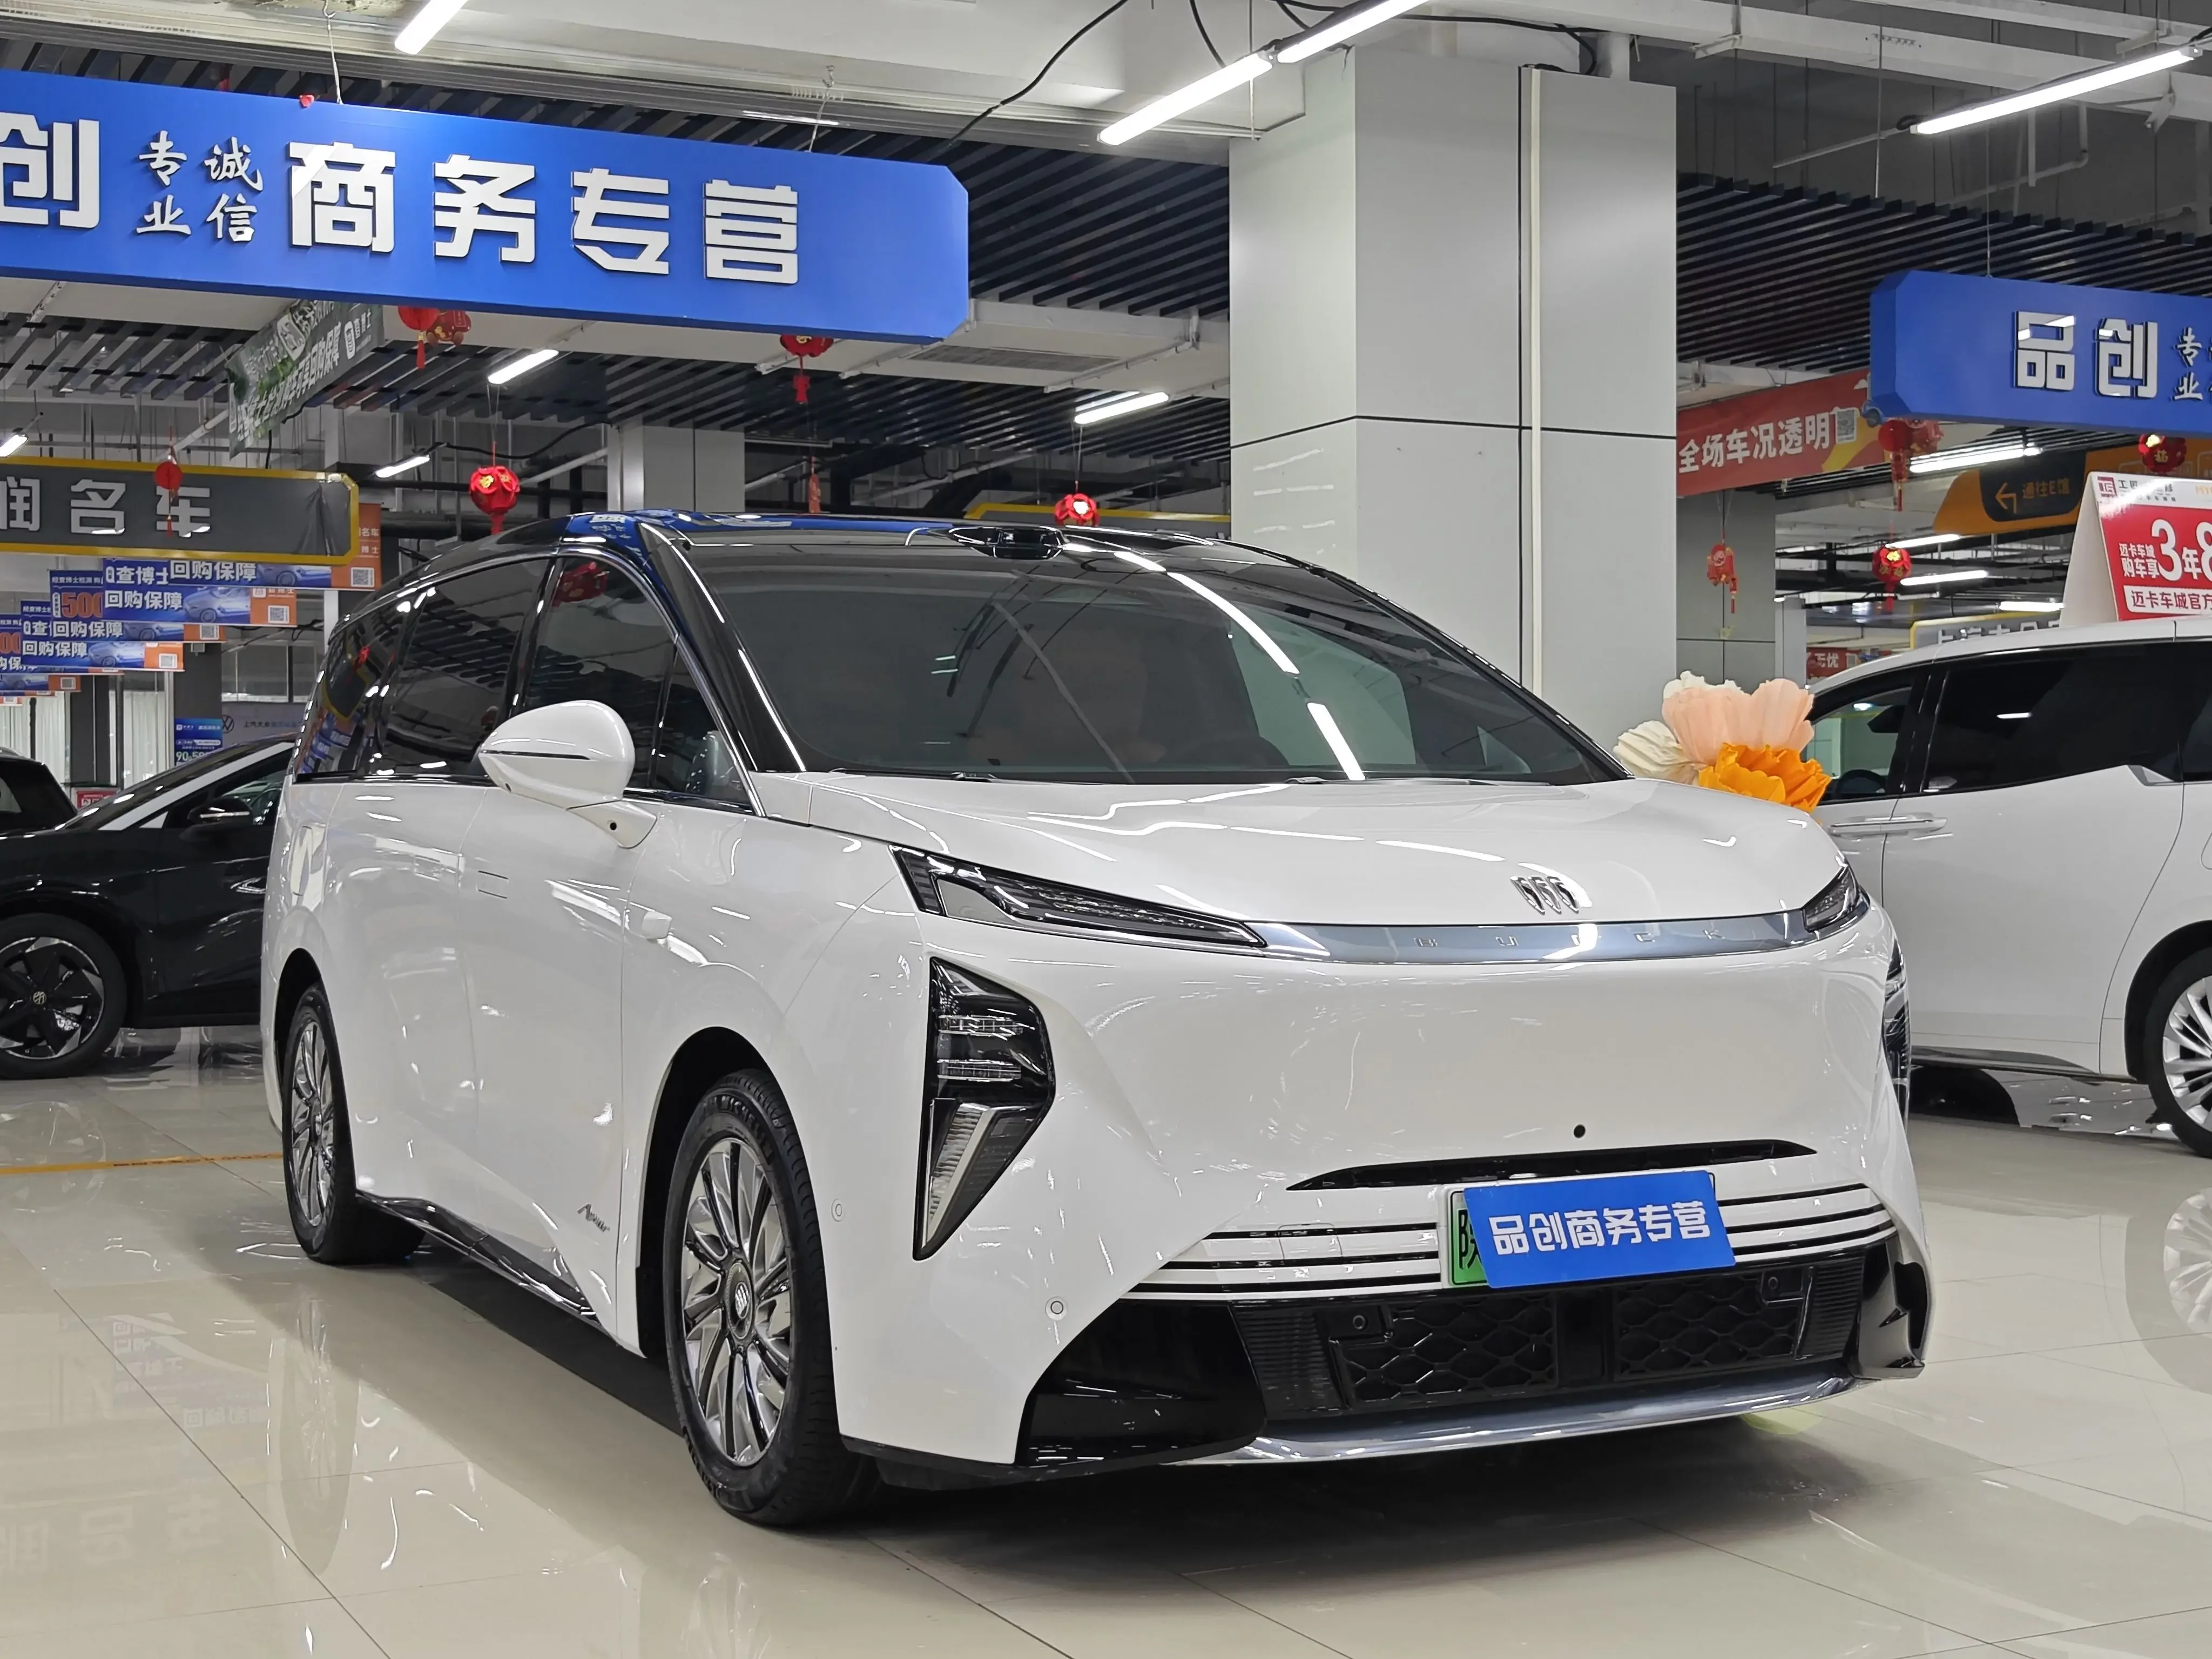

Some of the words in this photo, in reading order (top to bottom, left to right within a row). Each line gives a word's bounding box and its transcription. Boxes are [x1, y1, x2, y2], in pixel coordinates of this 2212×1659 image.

[0, 112, 99, 228] 创
[289, 141, 798, 285] 商务专营
[2014, 310, 2158, 399] 品创
[1678, 412, 1830, 473] 全场车况透明
[359, 527, 379, 537] 名车
[116, 565, 168, 585] 查博士
[170, 560, 257, 582] 回购保障
[2121, 558, 2160, 579] 购车享
[105, 590, 182, 610] 回购保障
[53, 621, 124, 638] 回购保障
[22, 640, 89, 657] 回购保障
[1488, 1200, 1711, 1256] 品创商务专营
